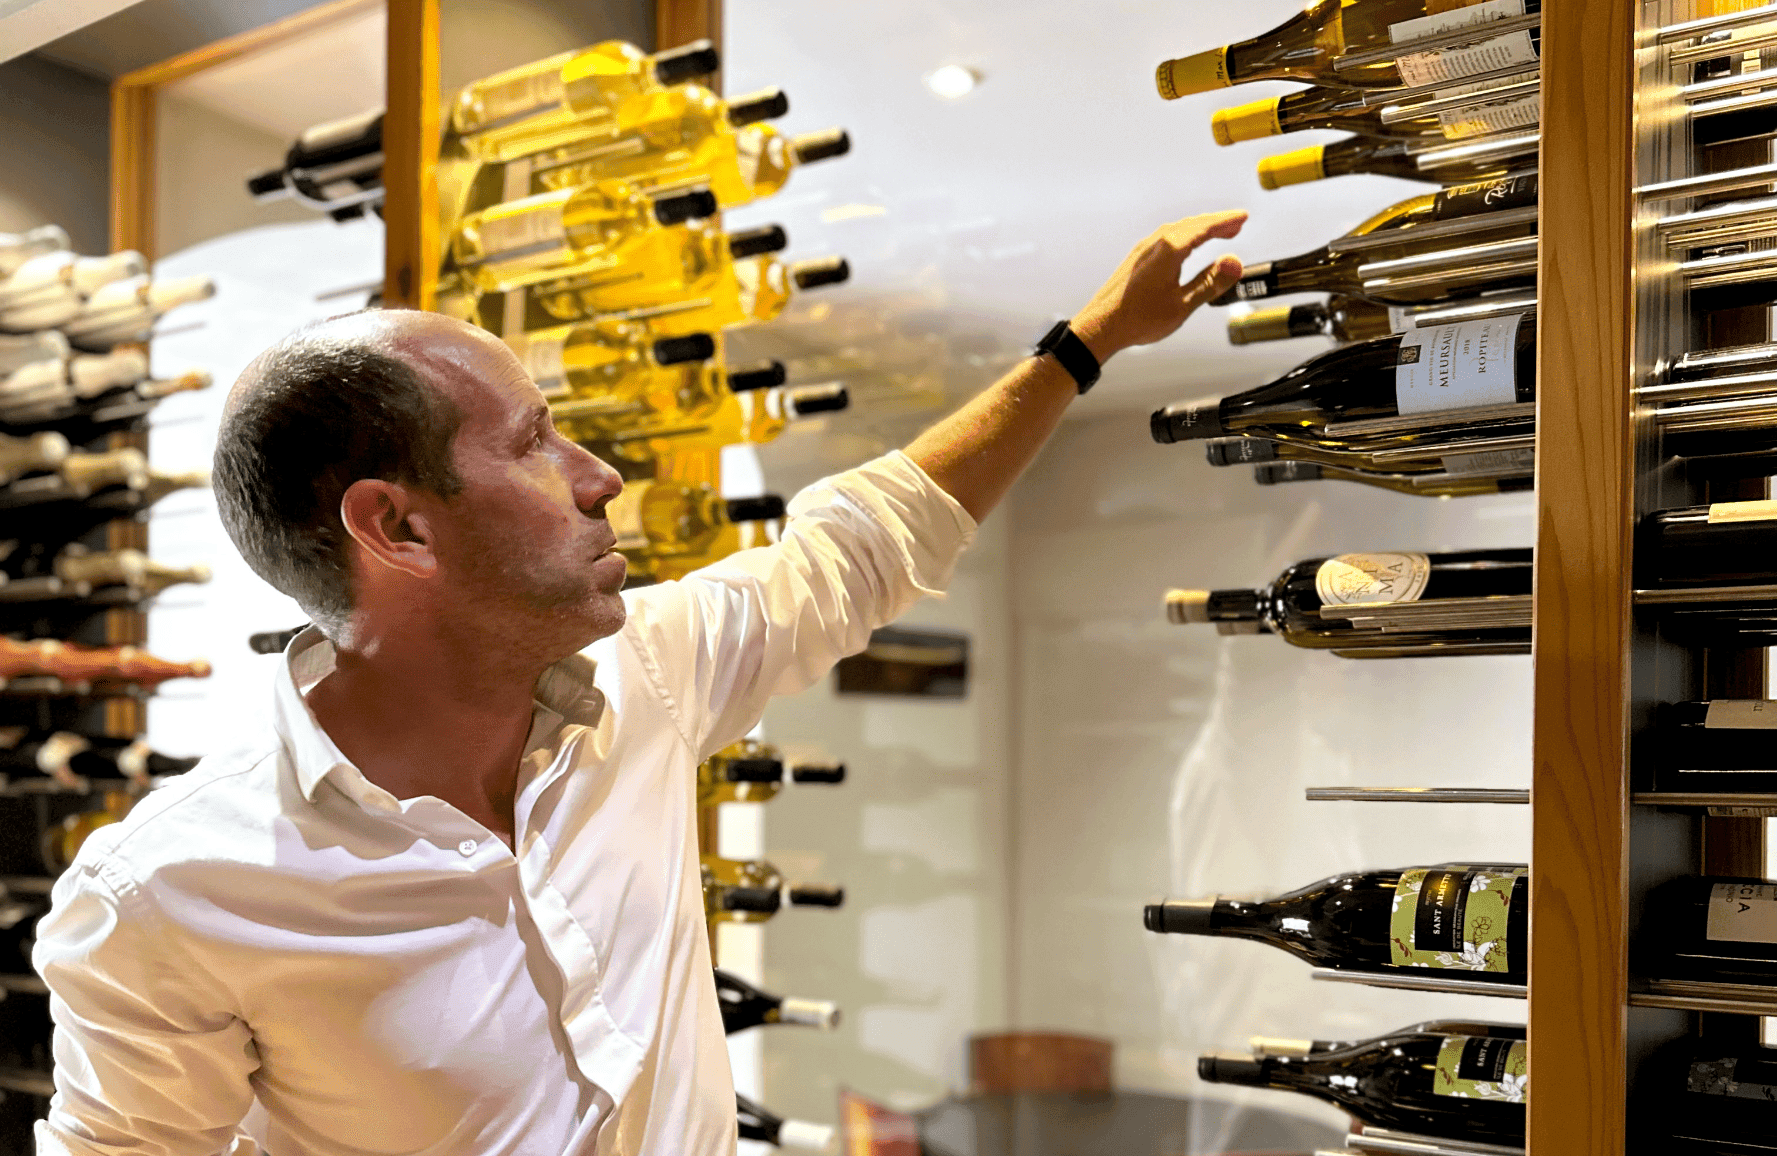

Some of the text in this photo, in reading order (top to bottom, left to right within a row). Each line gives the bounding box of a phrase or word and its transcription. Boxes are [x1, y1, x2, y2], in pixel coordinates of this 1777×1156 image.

[1439, 325, 1457, 388] MEURSAULT
[1463, 339, 1471, 355] 2018
[1478, 323, 1492, 374] ROPITEAU
[1432, 909, 1442, 935] SANT
[1476, 1048, 1488, 1067] SANT
